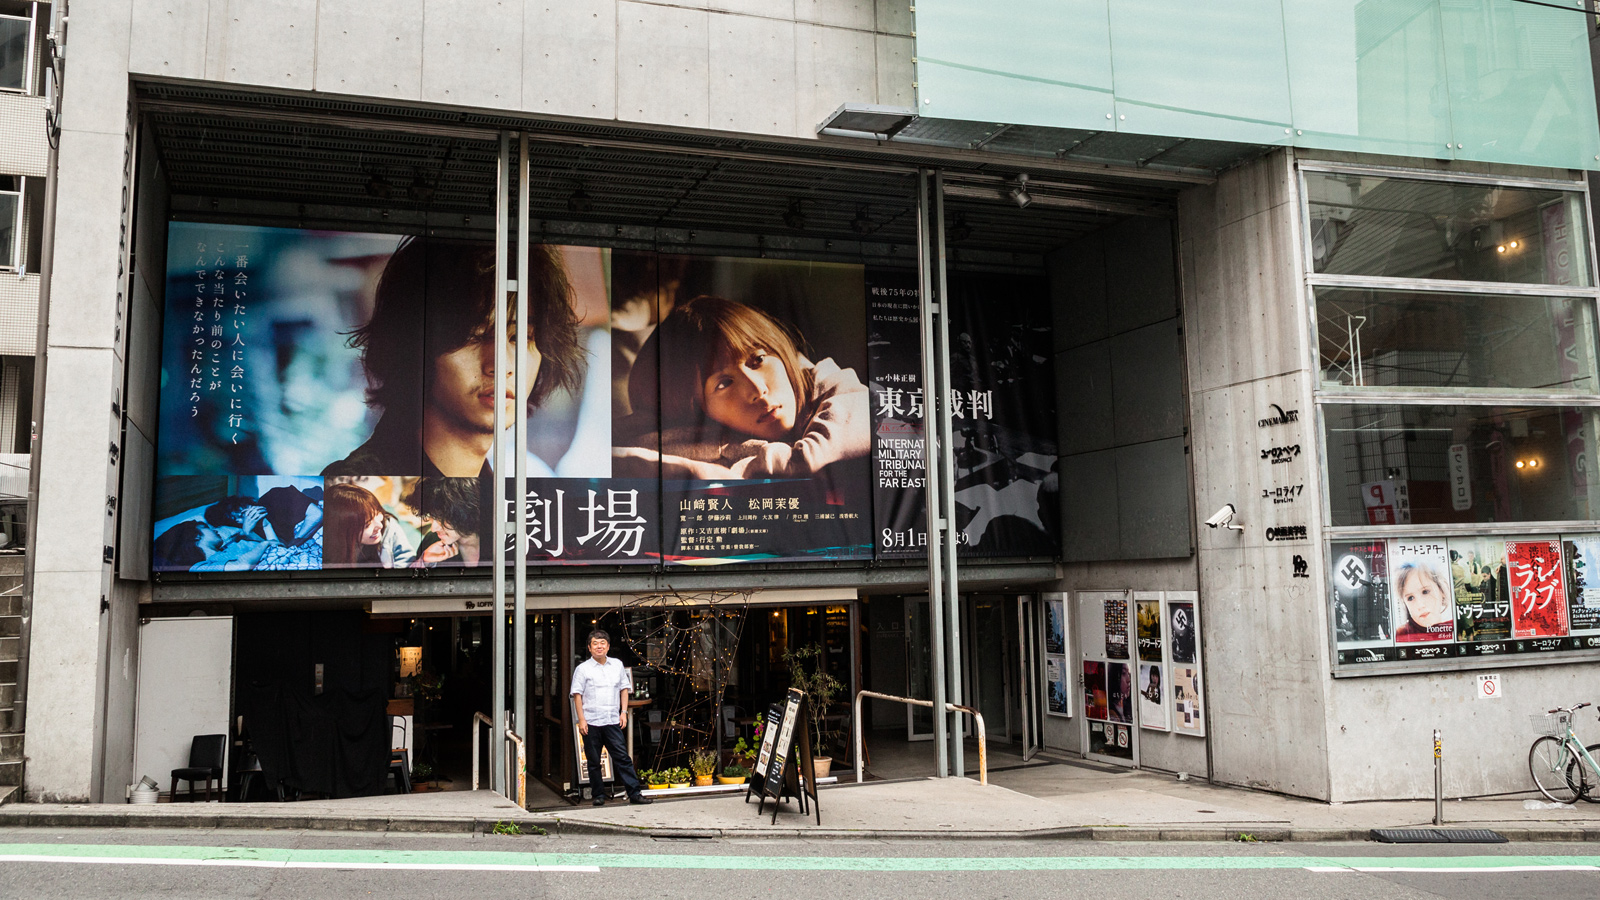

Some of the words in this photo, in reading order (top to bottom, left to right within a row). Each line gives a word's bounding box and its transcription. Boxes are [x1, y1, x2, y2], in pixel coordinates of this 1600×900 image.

[872, 302, 920, 310] 日本の現在に問いか
[209, 242, 225, 391] こんな当たり前のことが
[190, 242, 207, 418] なんでできなかったんだろう
[228, 244, 249, 445] 一番会いたい人に会いに行く
[885, 373, 917, 383] 小林正樹
[878, 449, 922, 459] MILITARY
[879, 470, 893, 478] FOR
[894, 470, 907, 478] THE
[879, 478, 899, 488] FAR
[901, 478, 926, 488] EAST
[748, 497, 800, 510] 松岡茉優
[505, 488, 648, 558] 劇場
[1399, 544, 1445, 556] アートシアター
[1457, 603, 1510, 620] ドヴラートフ
[1426, 624, 1453, 634] Ponette
[1443, 647, 1448, 655] 2
